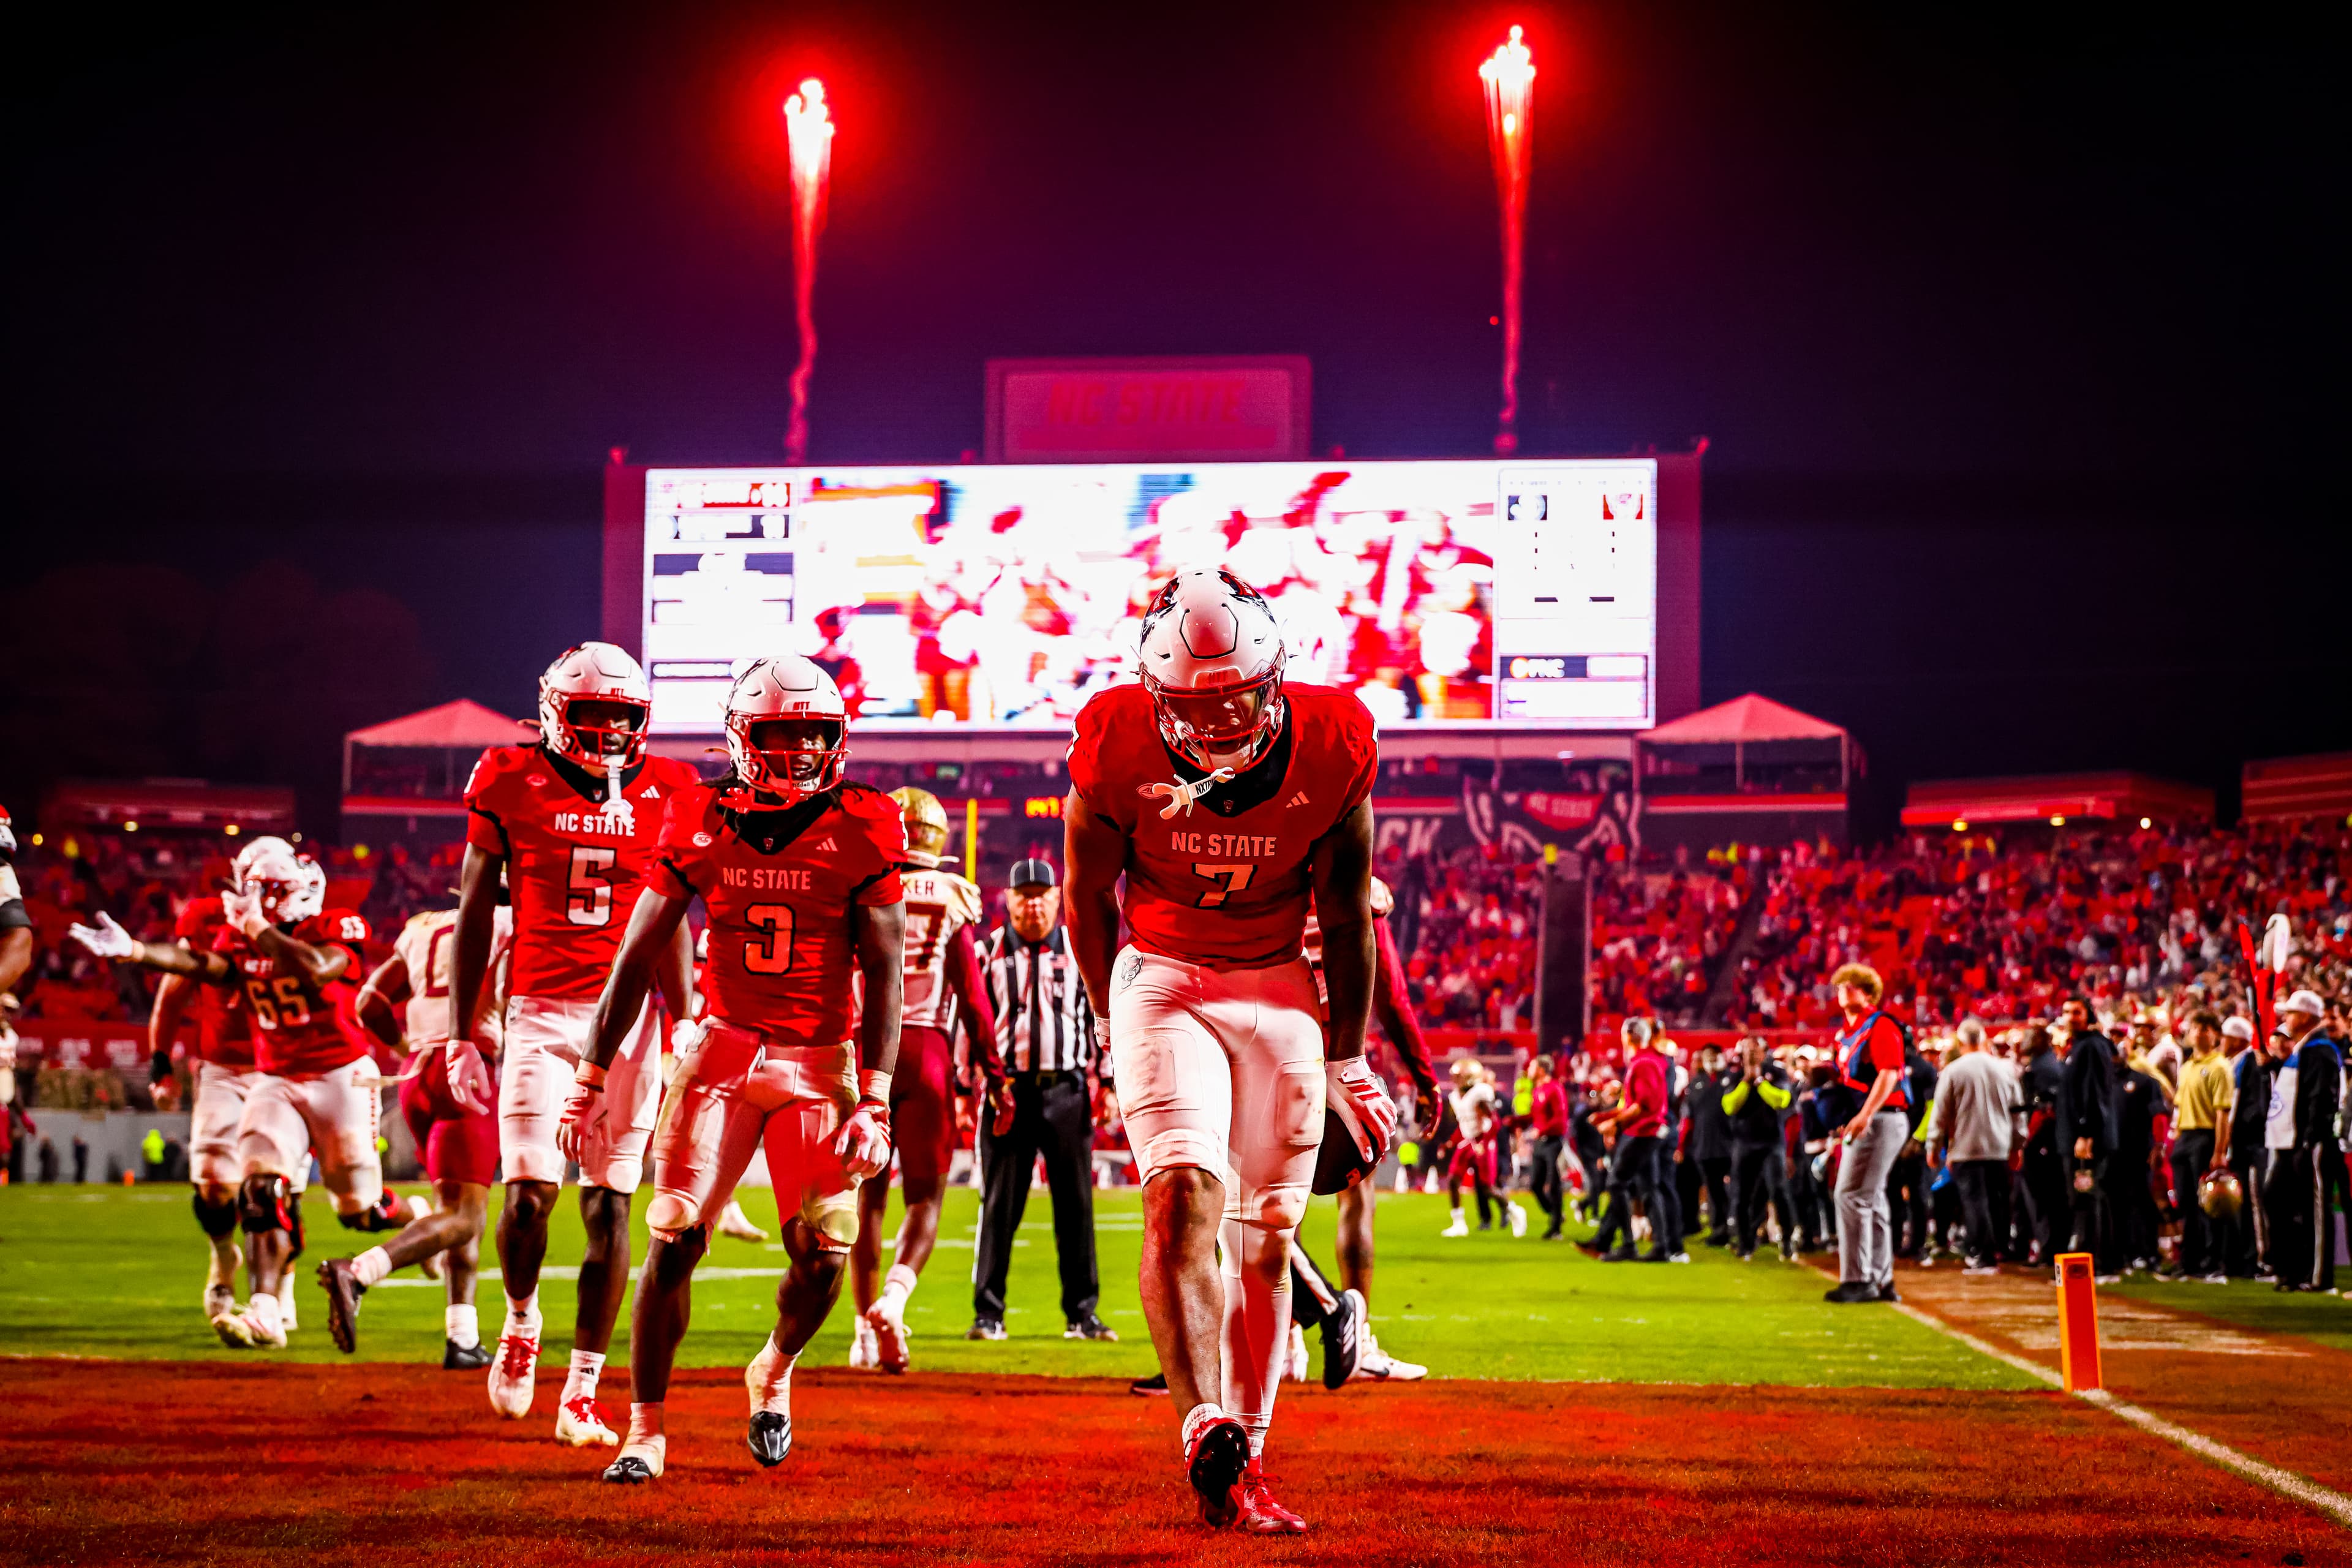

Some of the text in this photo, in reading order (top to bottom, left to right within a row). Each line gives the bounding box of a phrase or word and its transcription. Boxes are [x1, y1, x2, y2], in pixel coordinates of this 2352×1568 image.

[1048, 380, 1245, 424] NC STATE
[555, 813, 635, 837] NC STATE
[1172, 832, 1277, 857] NC STATE
[1376, 818, 1442, 855] CK
[566, 845, 616, 927] 5
[723, 867, 812, 890] NC STATE
[901, 878, 934, 897] KER
[1192, 862, 1258, 910] 7
[743, 902, 796, 976] 3
[246, 975, 311, 1030] 65
